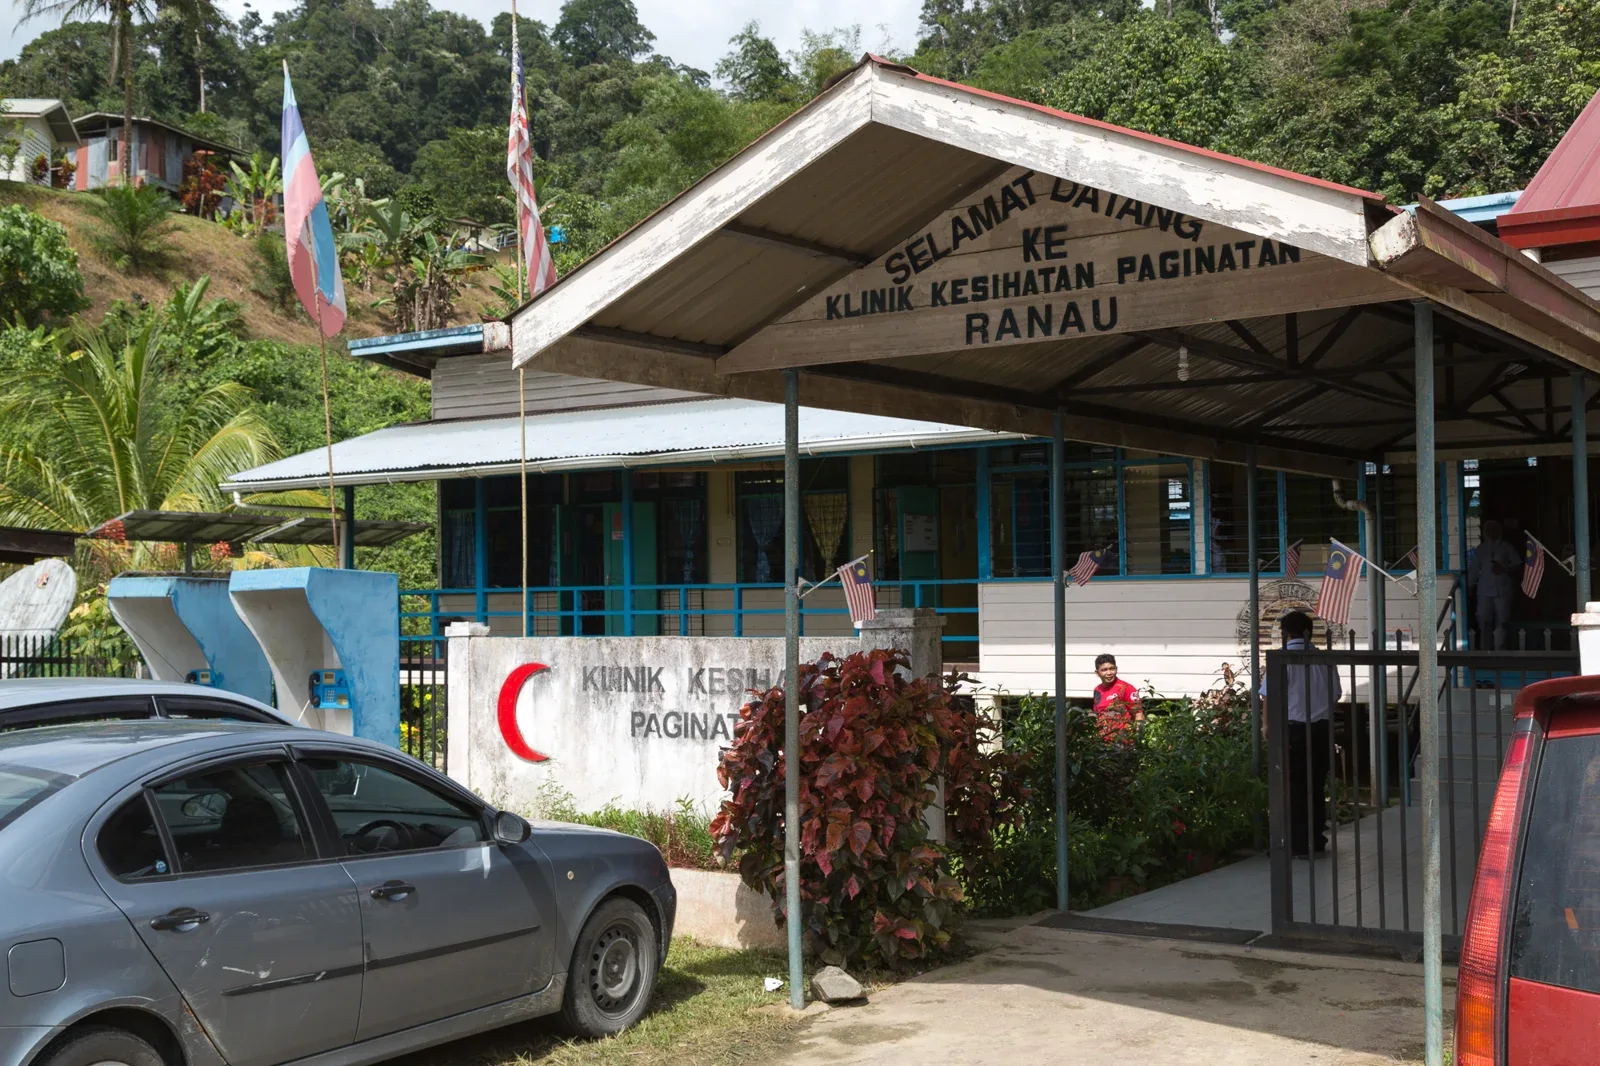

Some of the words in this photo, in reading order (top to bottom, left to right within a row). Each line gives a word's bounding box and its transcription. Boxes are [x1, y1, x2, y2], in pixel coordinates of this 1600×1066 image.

[885, 171, 1036, 285] SELAMAT
[1022, 225, 1069, 263] KE
[826, 285, 914, 320] KLINIK
[931, 262, 1095, 307] KESIHATAN
[1117, 239, 1300, 285] PAGINATAN
[965, 296, 1118, 346] RANAU
[582, 666, 665, 692] KLINIK
